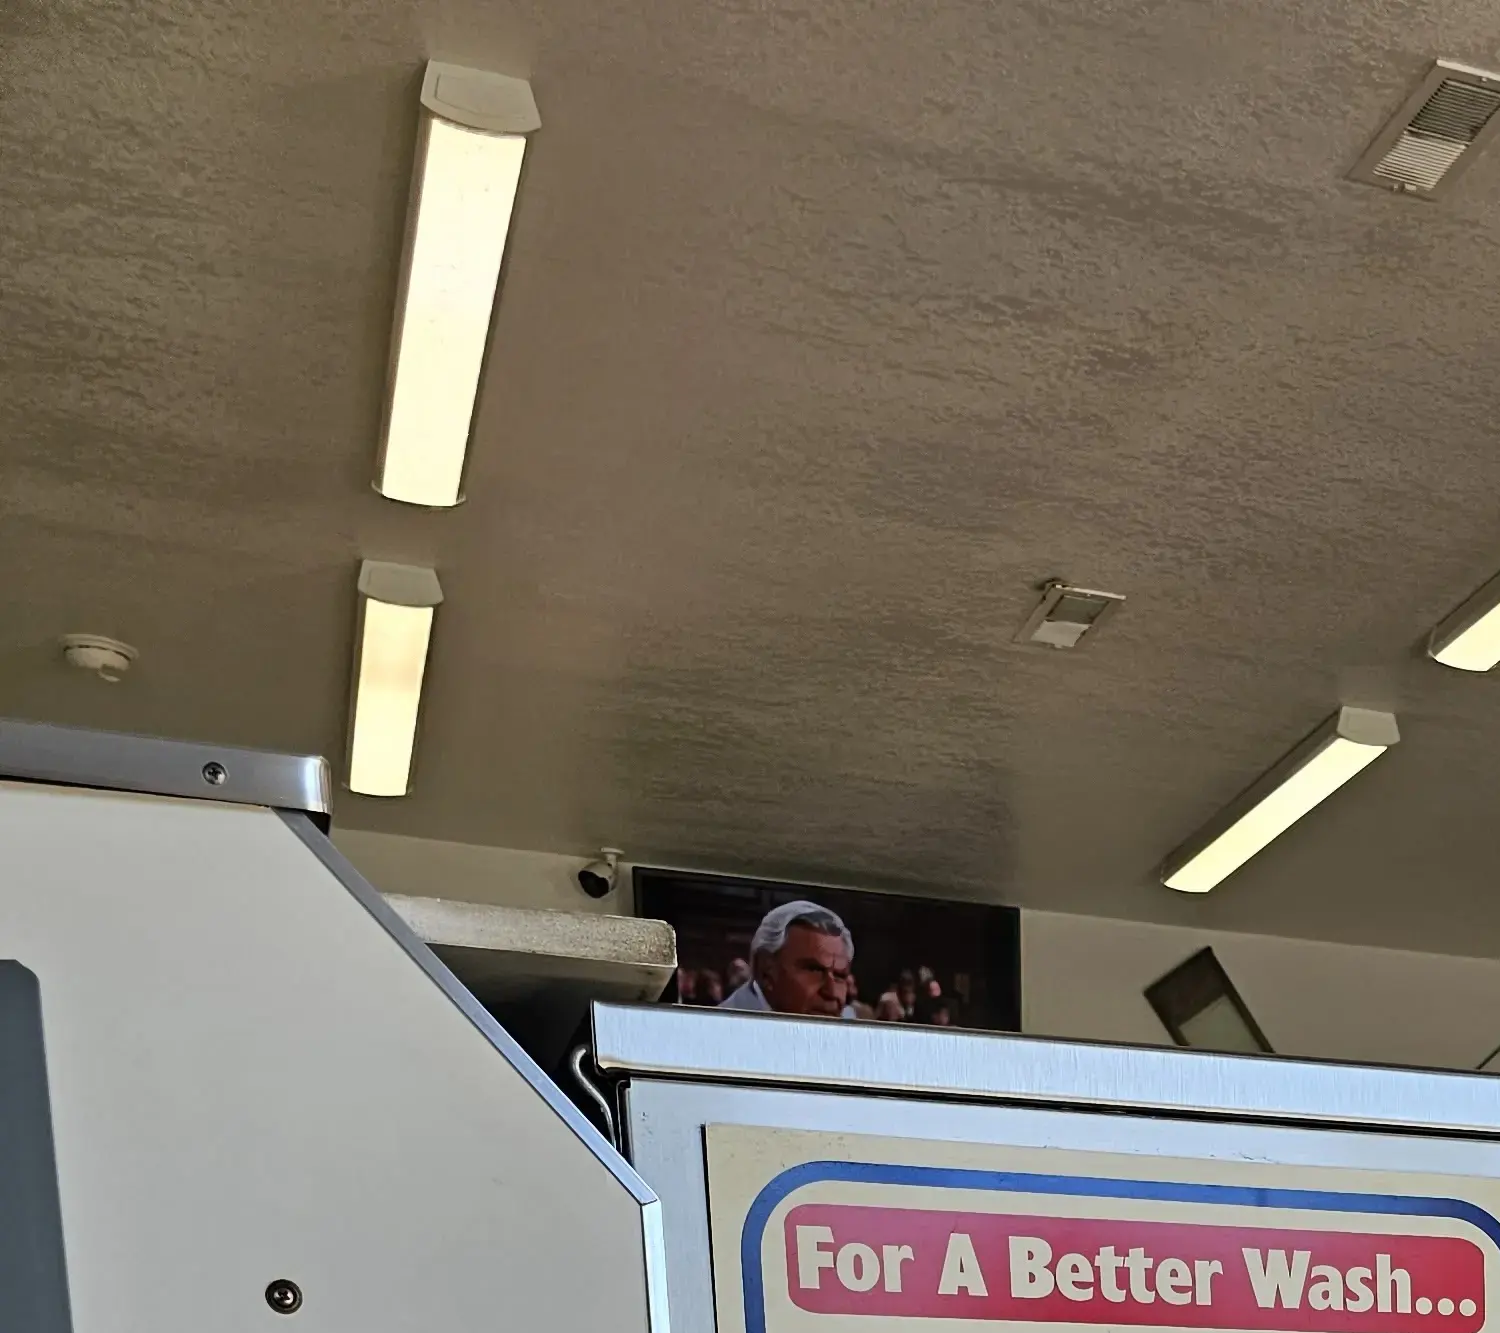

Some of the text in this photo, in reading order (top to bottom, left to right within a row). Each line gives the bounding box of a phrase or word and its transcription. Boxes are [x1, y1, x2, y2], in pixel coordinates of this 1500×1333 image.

[794, 1225, 1478, 1318] For A Better Wash...
